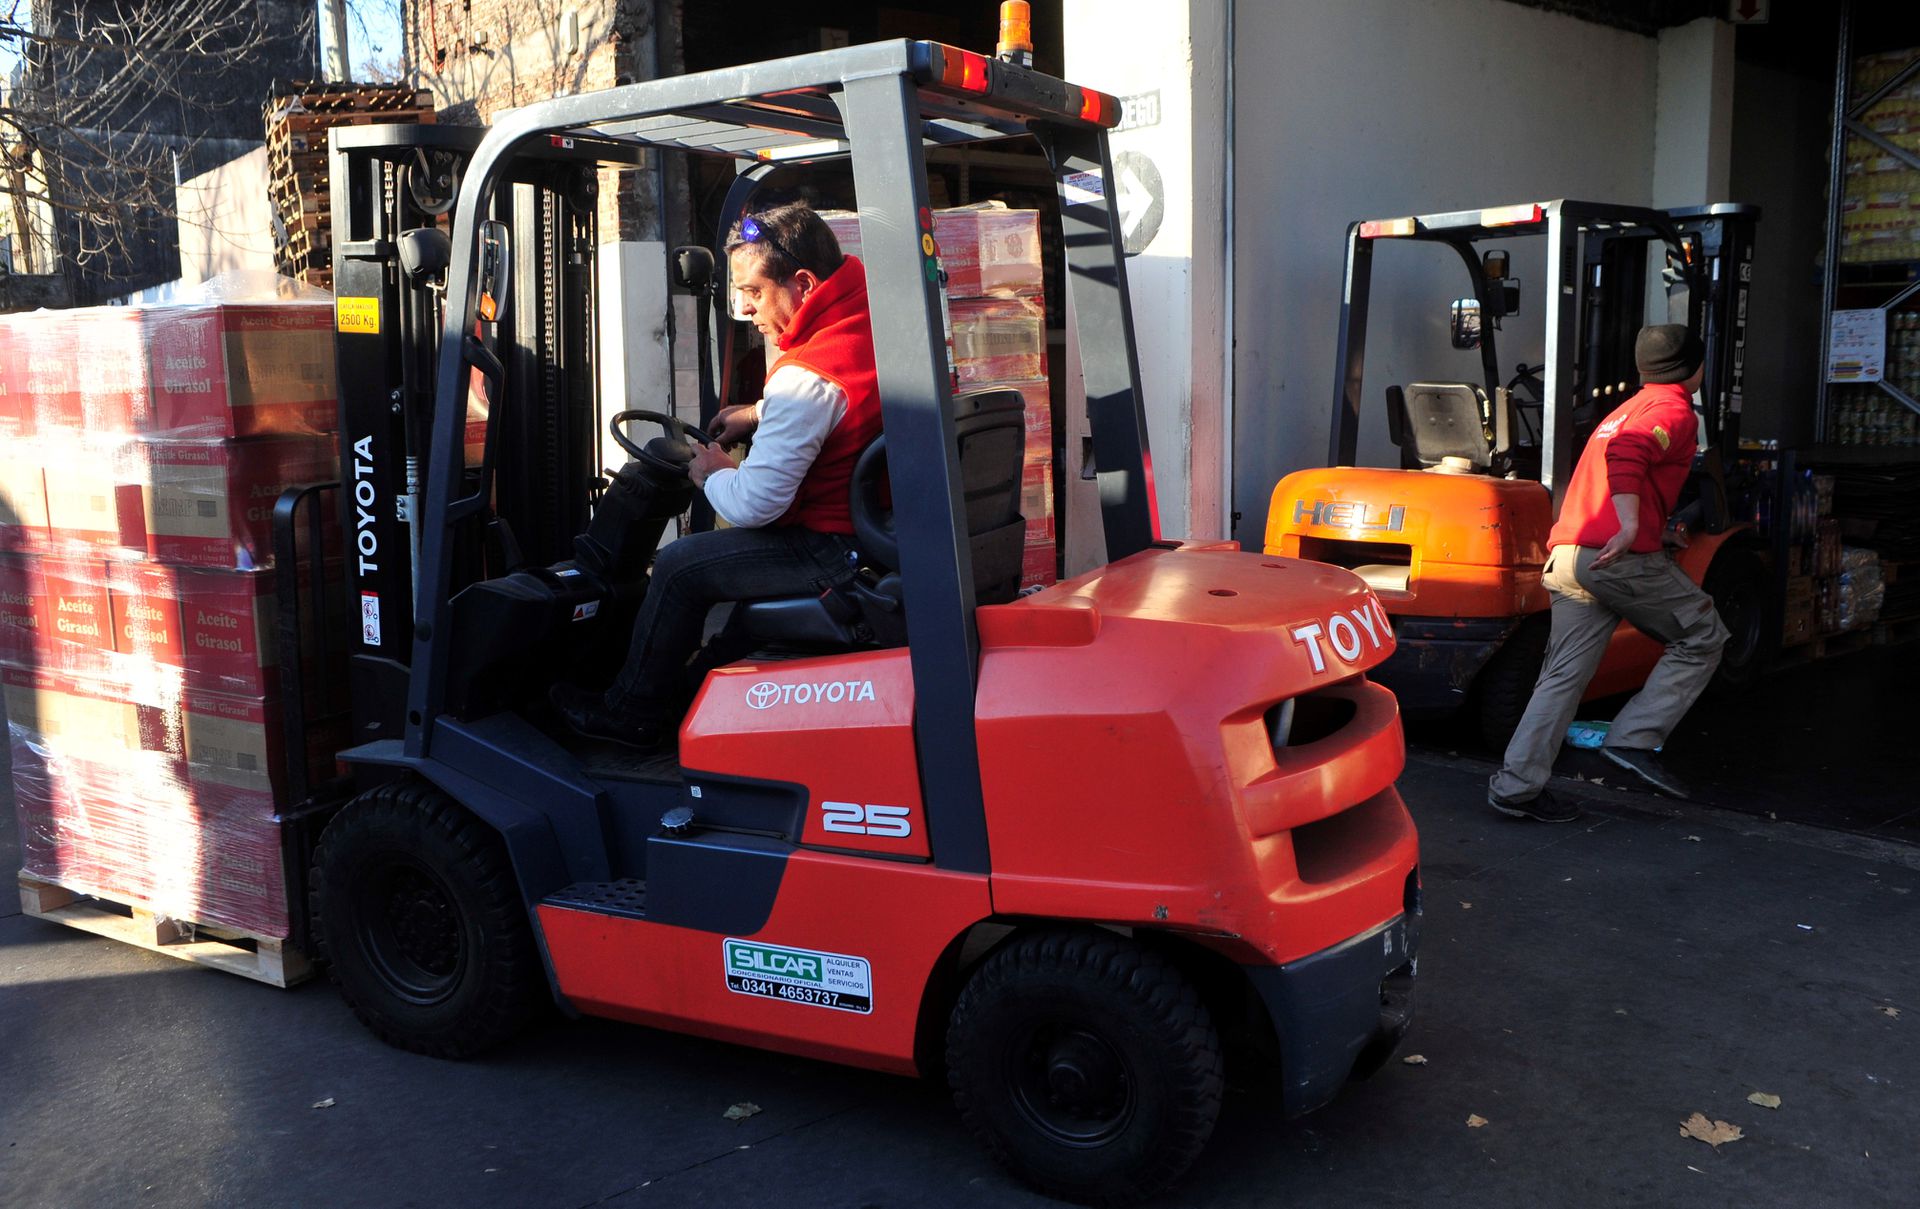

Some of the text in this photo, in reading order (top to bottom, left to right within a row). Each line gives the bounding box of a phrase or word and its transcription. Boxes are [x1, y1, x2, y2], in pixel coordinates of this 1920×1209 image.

[340, 313, 361, 326] 2500
[164, 355, 206, 370] Aceite
[164, 378, 212, 394] Girasol
[178, 450, 210, 460] Girasol
[353, 435, 379, 577] TOYOTA
[1293, 500, 1408, 532] HELI
[1, 590, 34, 606] Aceite
[57, 597, 94, 615] Aceite
[1, 611, 39, 628] Girasol
[125, 604, 163, 622] Aceite
[197, 611, 238, 629] Aceite
[57, 618, 99, 637] Girasol
[124, 625, 168, 645] Girasol
[195, 632, 243, 652] Girasol
[781, 681, 876, 704] TOYOTA
[218, 703, 249, 717] Girasol
[822, 801, 911, 838] 25
[734, 948, 818, 978] SILCAR
[826, 958, 860, 969] ALQUILER
[731, 969, 823, 989] CONCESIONARIO OFICIAL
[827, 968, 854, 978] VENTAS
[742, 979, 774, 996] 0341
[779, 985, 839, 1006] 4653737
[828, 978, 864, 989] SERVICIOS
